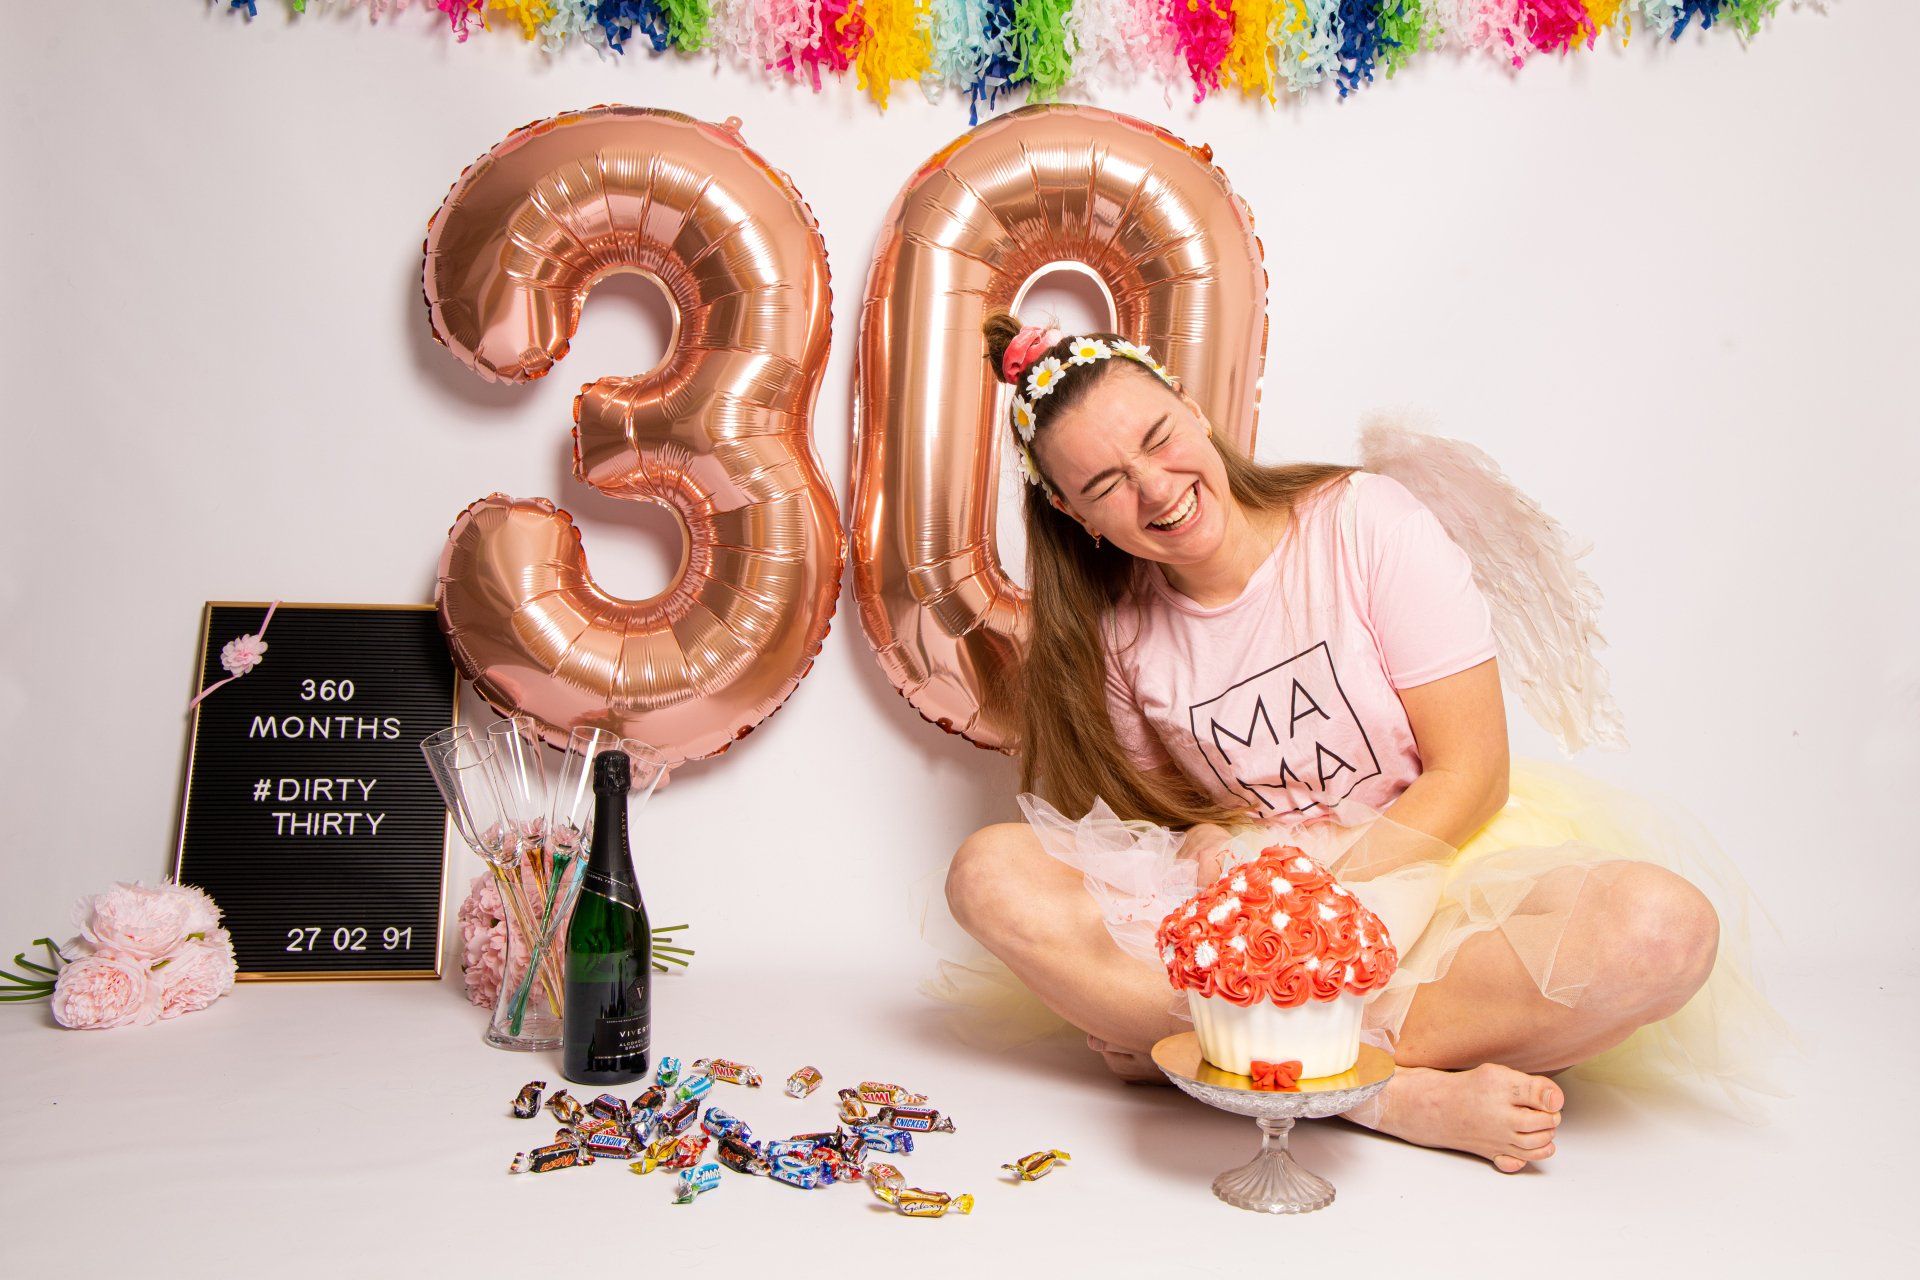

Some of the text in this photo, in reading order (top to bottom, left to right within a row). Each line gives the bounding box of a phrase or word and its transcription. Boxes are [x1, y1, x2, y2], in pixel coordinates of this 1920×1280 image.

[300, 679, 355, 702] 360
[249, 715, 401, 740] MONTHS
[1210, 677, 1331, 766] MA
[1236, 741, 1357, 811] MA
[253, 778, 377, 802] #DIRTY
[272, 812, 386, 836] THIRTY
[286, 926, 413, 952] 27 02 91
[862, 1090, 895, 1106] TWIX
[894, 1117, 929, 1129] SNICKERS
[904, 1200, 943, 1215] Galaxy
